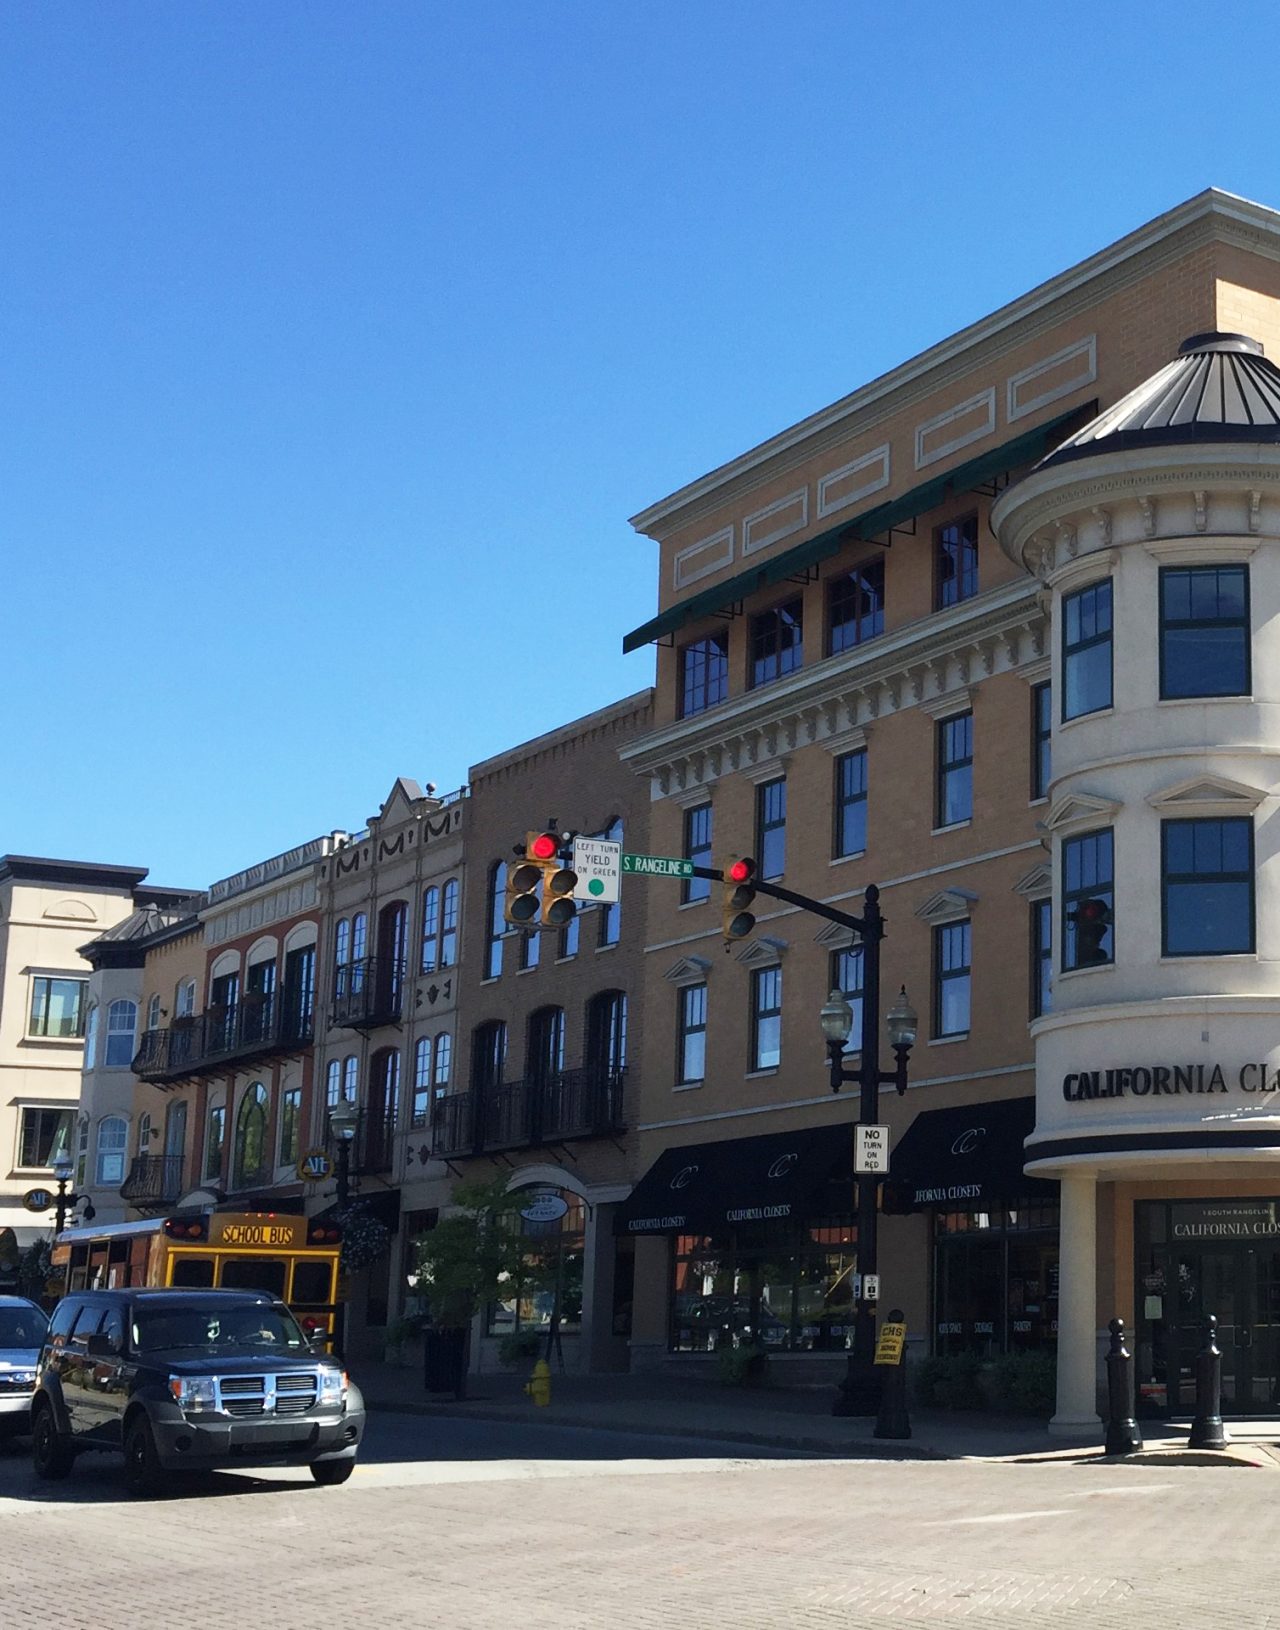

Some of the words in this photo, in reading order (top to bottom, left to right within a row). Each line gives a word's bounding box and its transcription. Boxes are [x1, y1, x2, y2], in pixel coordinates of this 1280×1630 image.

[576, 843, 595, 852] LEFT
[601, 843, 619, 854] TURN
[585, 854, 610, 866] YIELD
[577, 866, 588, 874] ON
[593, 867, 617, 877] GREEN
[635, 858, 680, 875] RANGELINE
[683, 864, 692, 874] RD
[1062, 1063, 1229, 1101] CALIFORNIA
[865, 1130, 880, 1139] NO
[863, 1141, 882, 1149] TURN
[867, 1151, 877, 1159] ON
[864, 1161, 879, 1169] RED
[948, 1184, 980, 1199] CLOSETS
[727, 1208, 763, 1221] CALIFORNIA
[763, 1204, 791, 1218] CLOSETS
[1208, 1209, 1232, 1217] SOUTH
[629, 1218, 660, 1230] CALIFORNIA
[661, 1216, 686, 1228] CLOSETS
[223, 1226, 268, 1244] SCHOOL
[270, 1227, 293, 1244] BUS
[1174, 1223, 1250, 1236] CALIFORNIA
[882, 1327, 903, 1336] CHS
